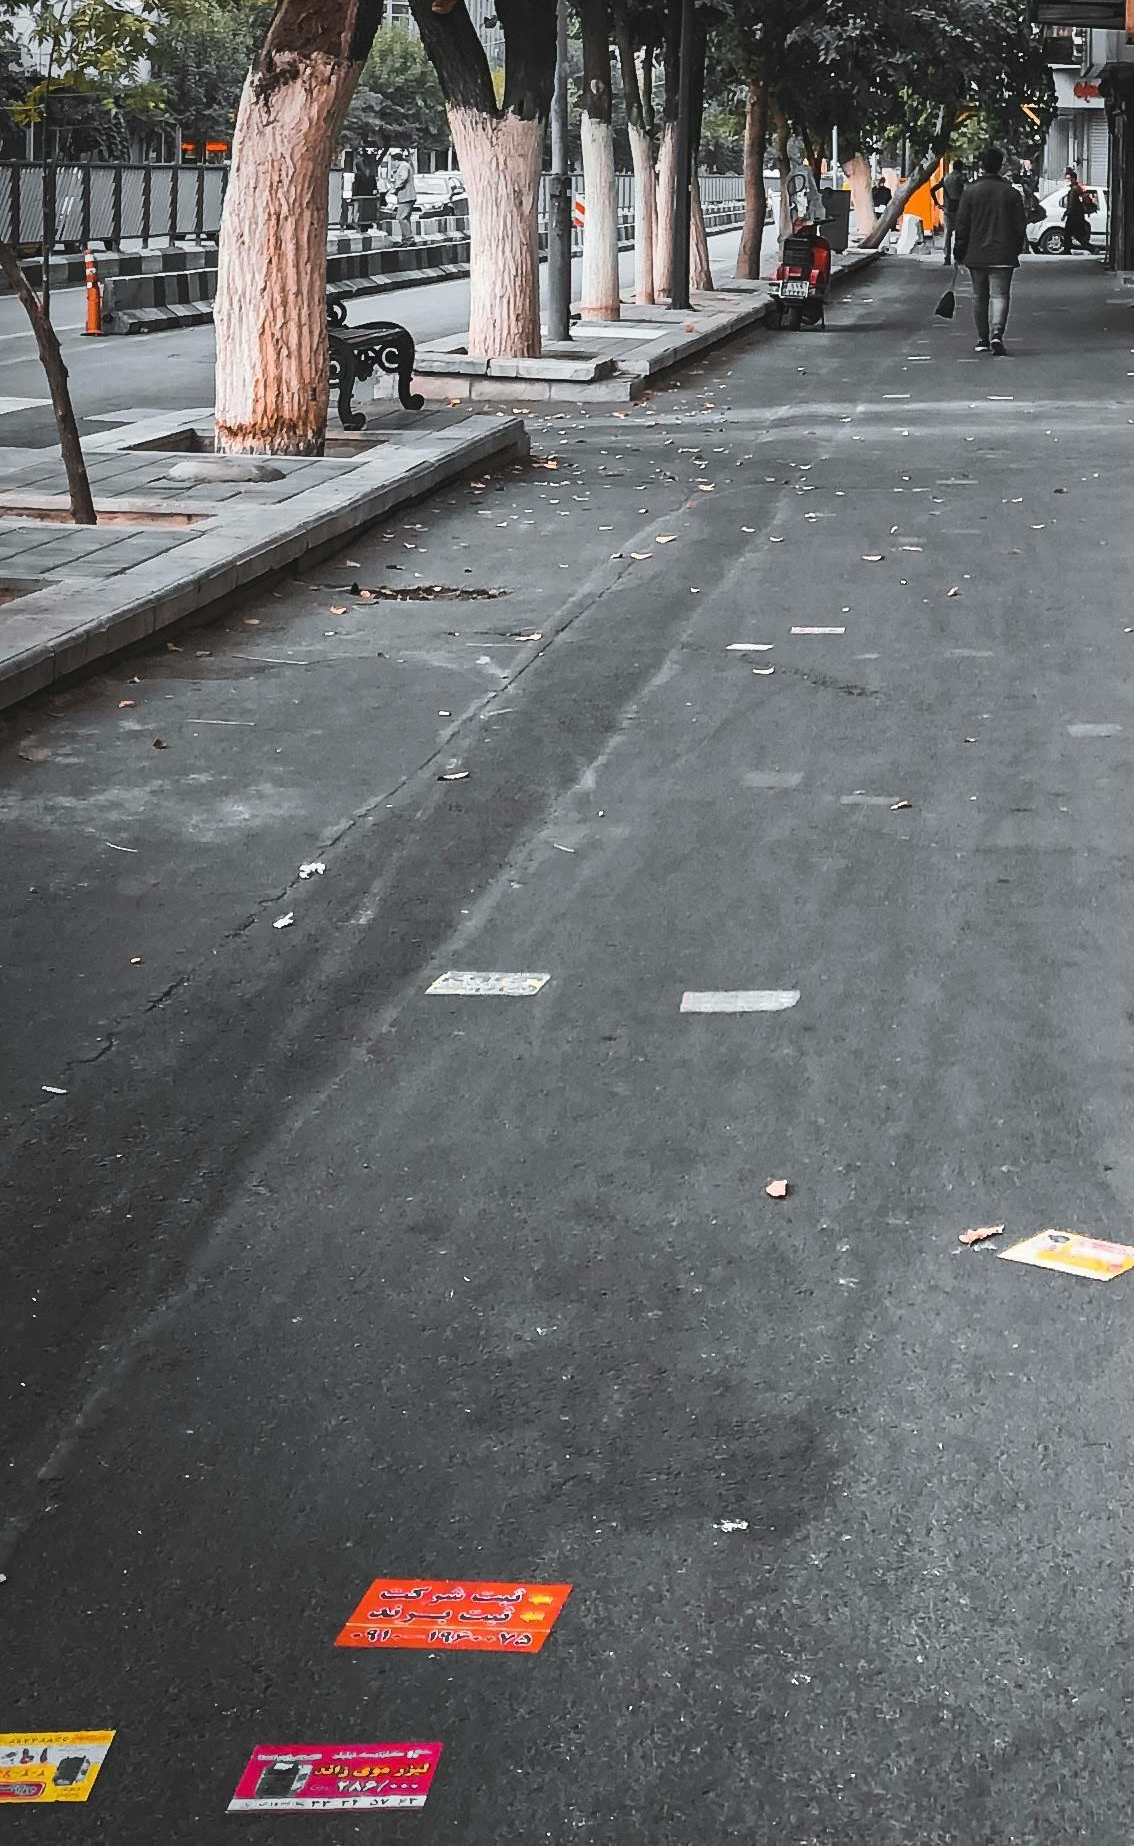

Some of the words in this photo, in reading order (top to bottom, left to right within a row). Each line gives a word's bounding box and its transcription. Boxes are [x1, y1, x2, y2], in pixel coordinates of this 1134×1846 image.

[379, 1586, 466, 1605] شرکت
[471, 1587, 526, 1606] ثبت
[368, 1605, 451, 1625] برند
[459, 1606, 515, 1625] ثبت
[353, 1767, 391, 1777] موی
[393, 1762, 430, 1777] لیزر
